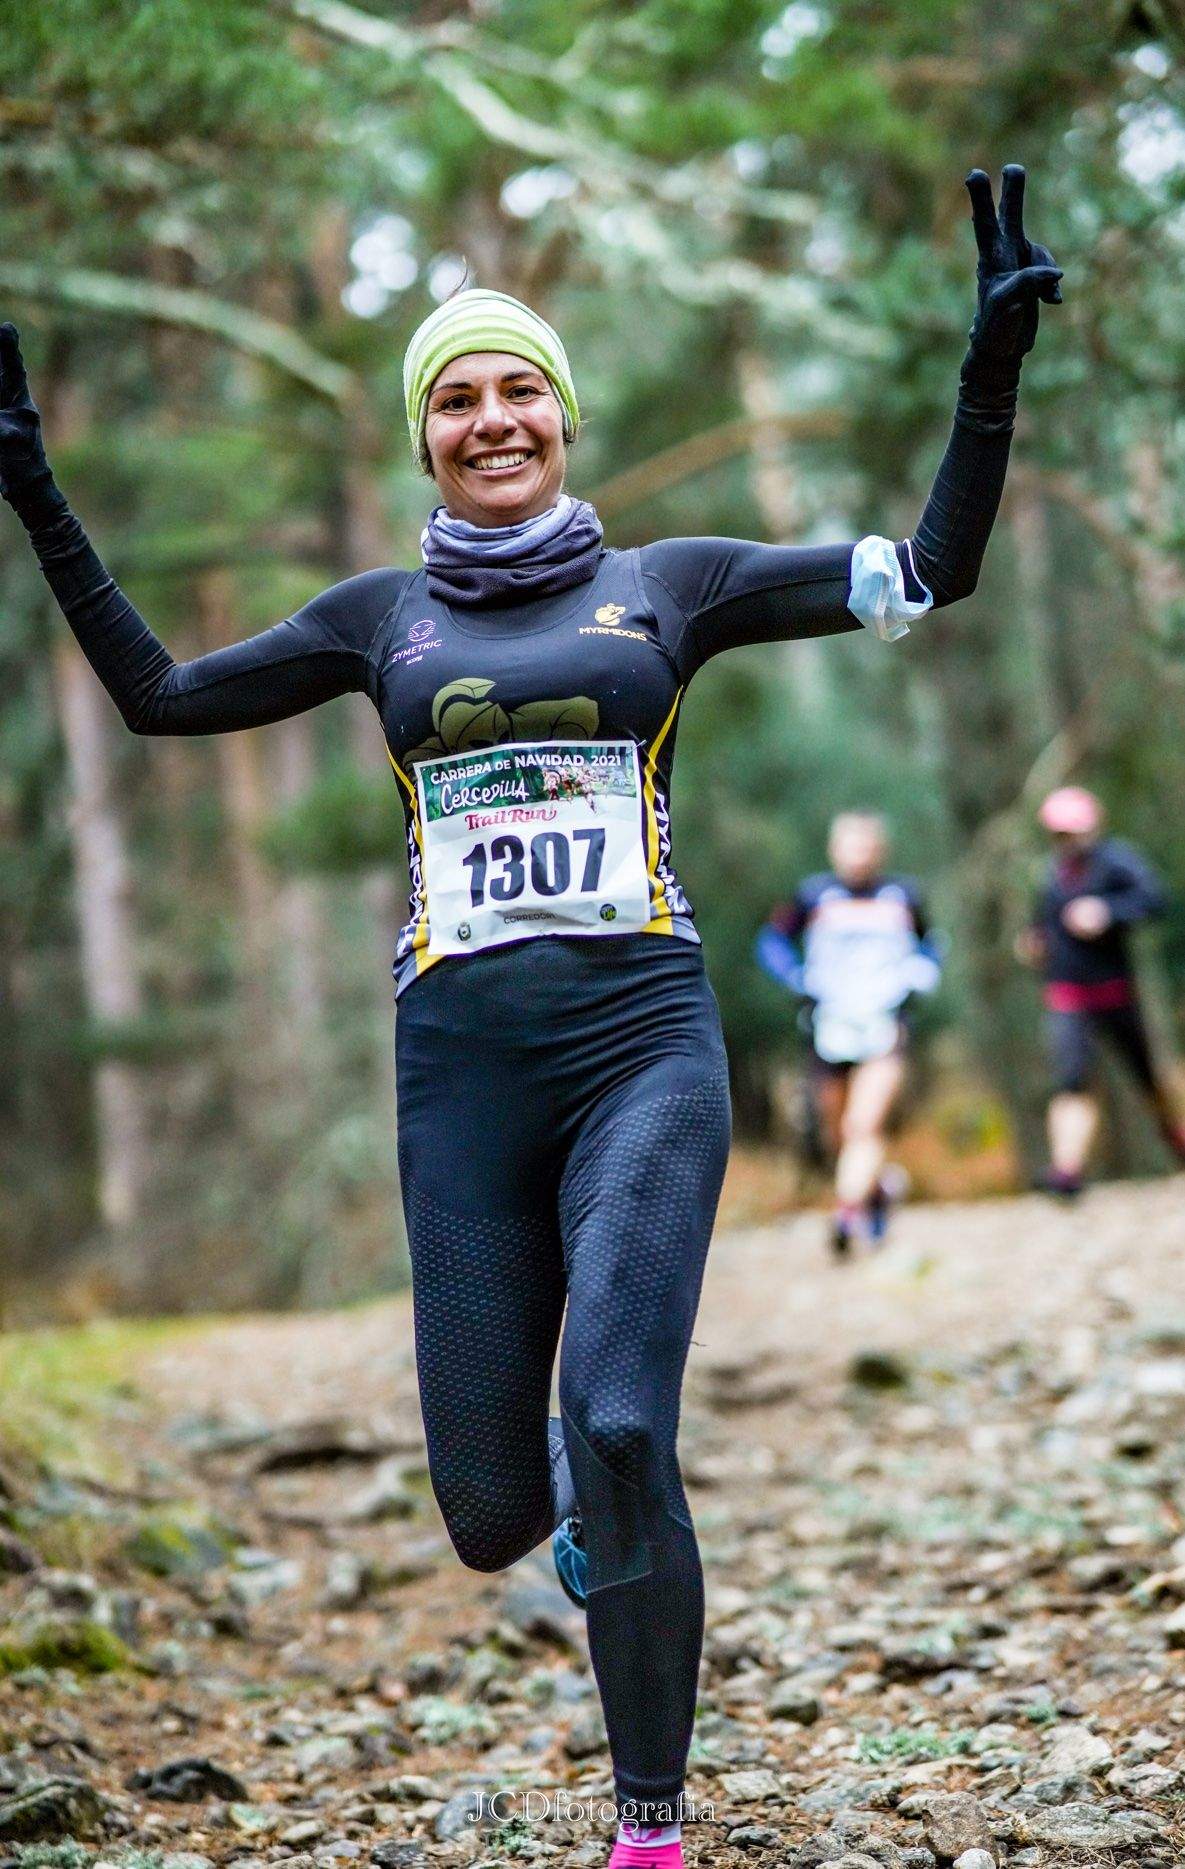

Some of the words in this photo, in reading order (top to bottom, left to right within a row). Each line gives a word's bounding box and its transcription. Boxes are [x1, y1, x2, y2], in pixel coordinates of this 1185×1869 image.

[392, 639, 443, 663] ZYMETRIC
[430, 763, 492, 785] CARRERA
[496, 760, 511, 771] DE
[514, 754, 585, 768] NAVIDAD
[591, 755, 621, 767] 2021
[465, 810, 507, 831] Trail
[509, 808, 557, 823] Run
[462, 828, 606, 908] 1307
